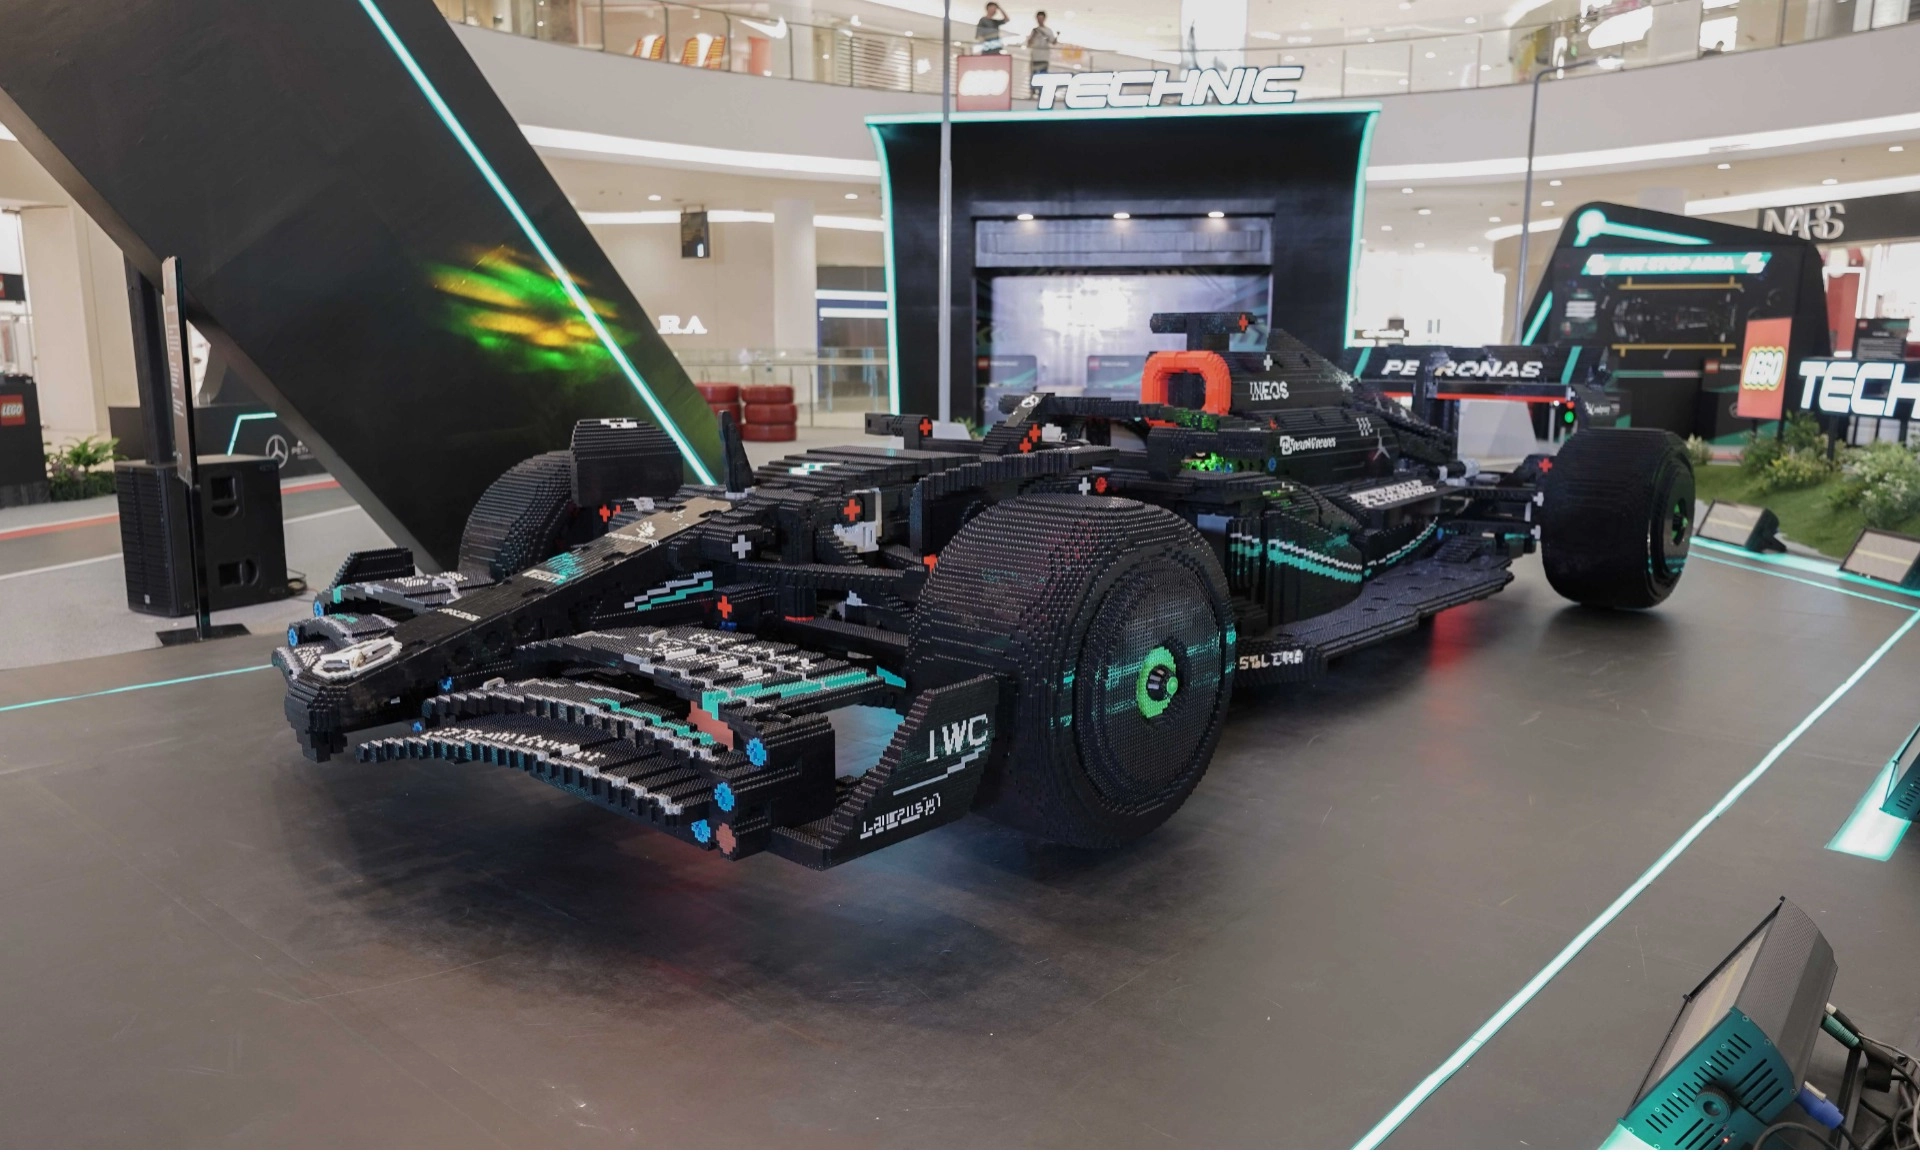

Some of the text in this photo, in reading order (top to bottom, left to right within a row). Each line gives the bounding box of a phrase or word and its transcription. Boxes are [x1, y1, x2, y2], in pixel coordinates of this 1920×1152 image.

[1031, 66, 1303, 109] TECHNIC
[1763, 202, 1846, 240] NARS
[1381, 359, 1544, 379] PERONAS
[1249, 381, 1290, 401] INEOS
[2, 403, 23, 416] LEGO
[926, 713, 989, 762] IWC
